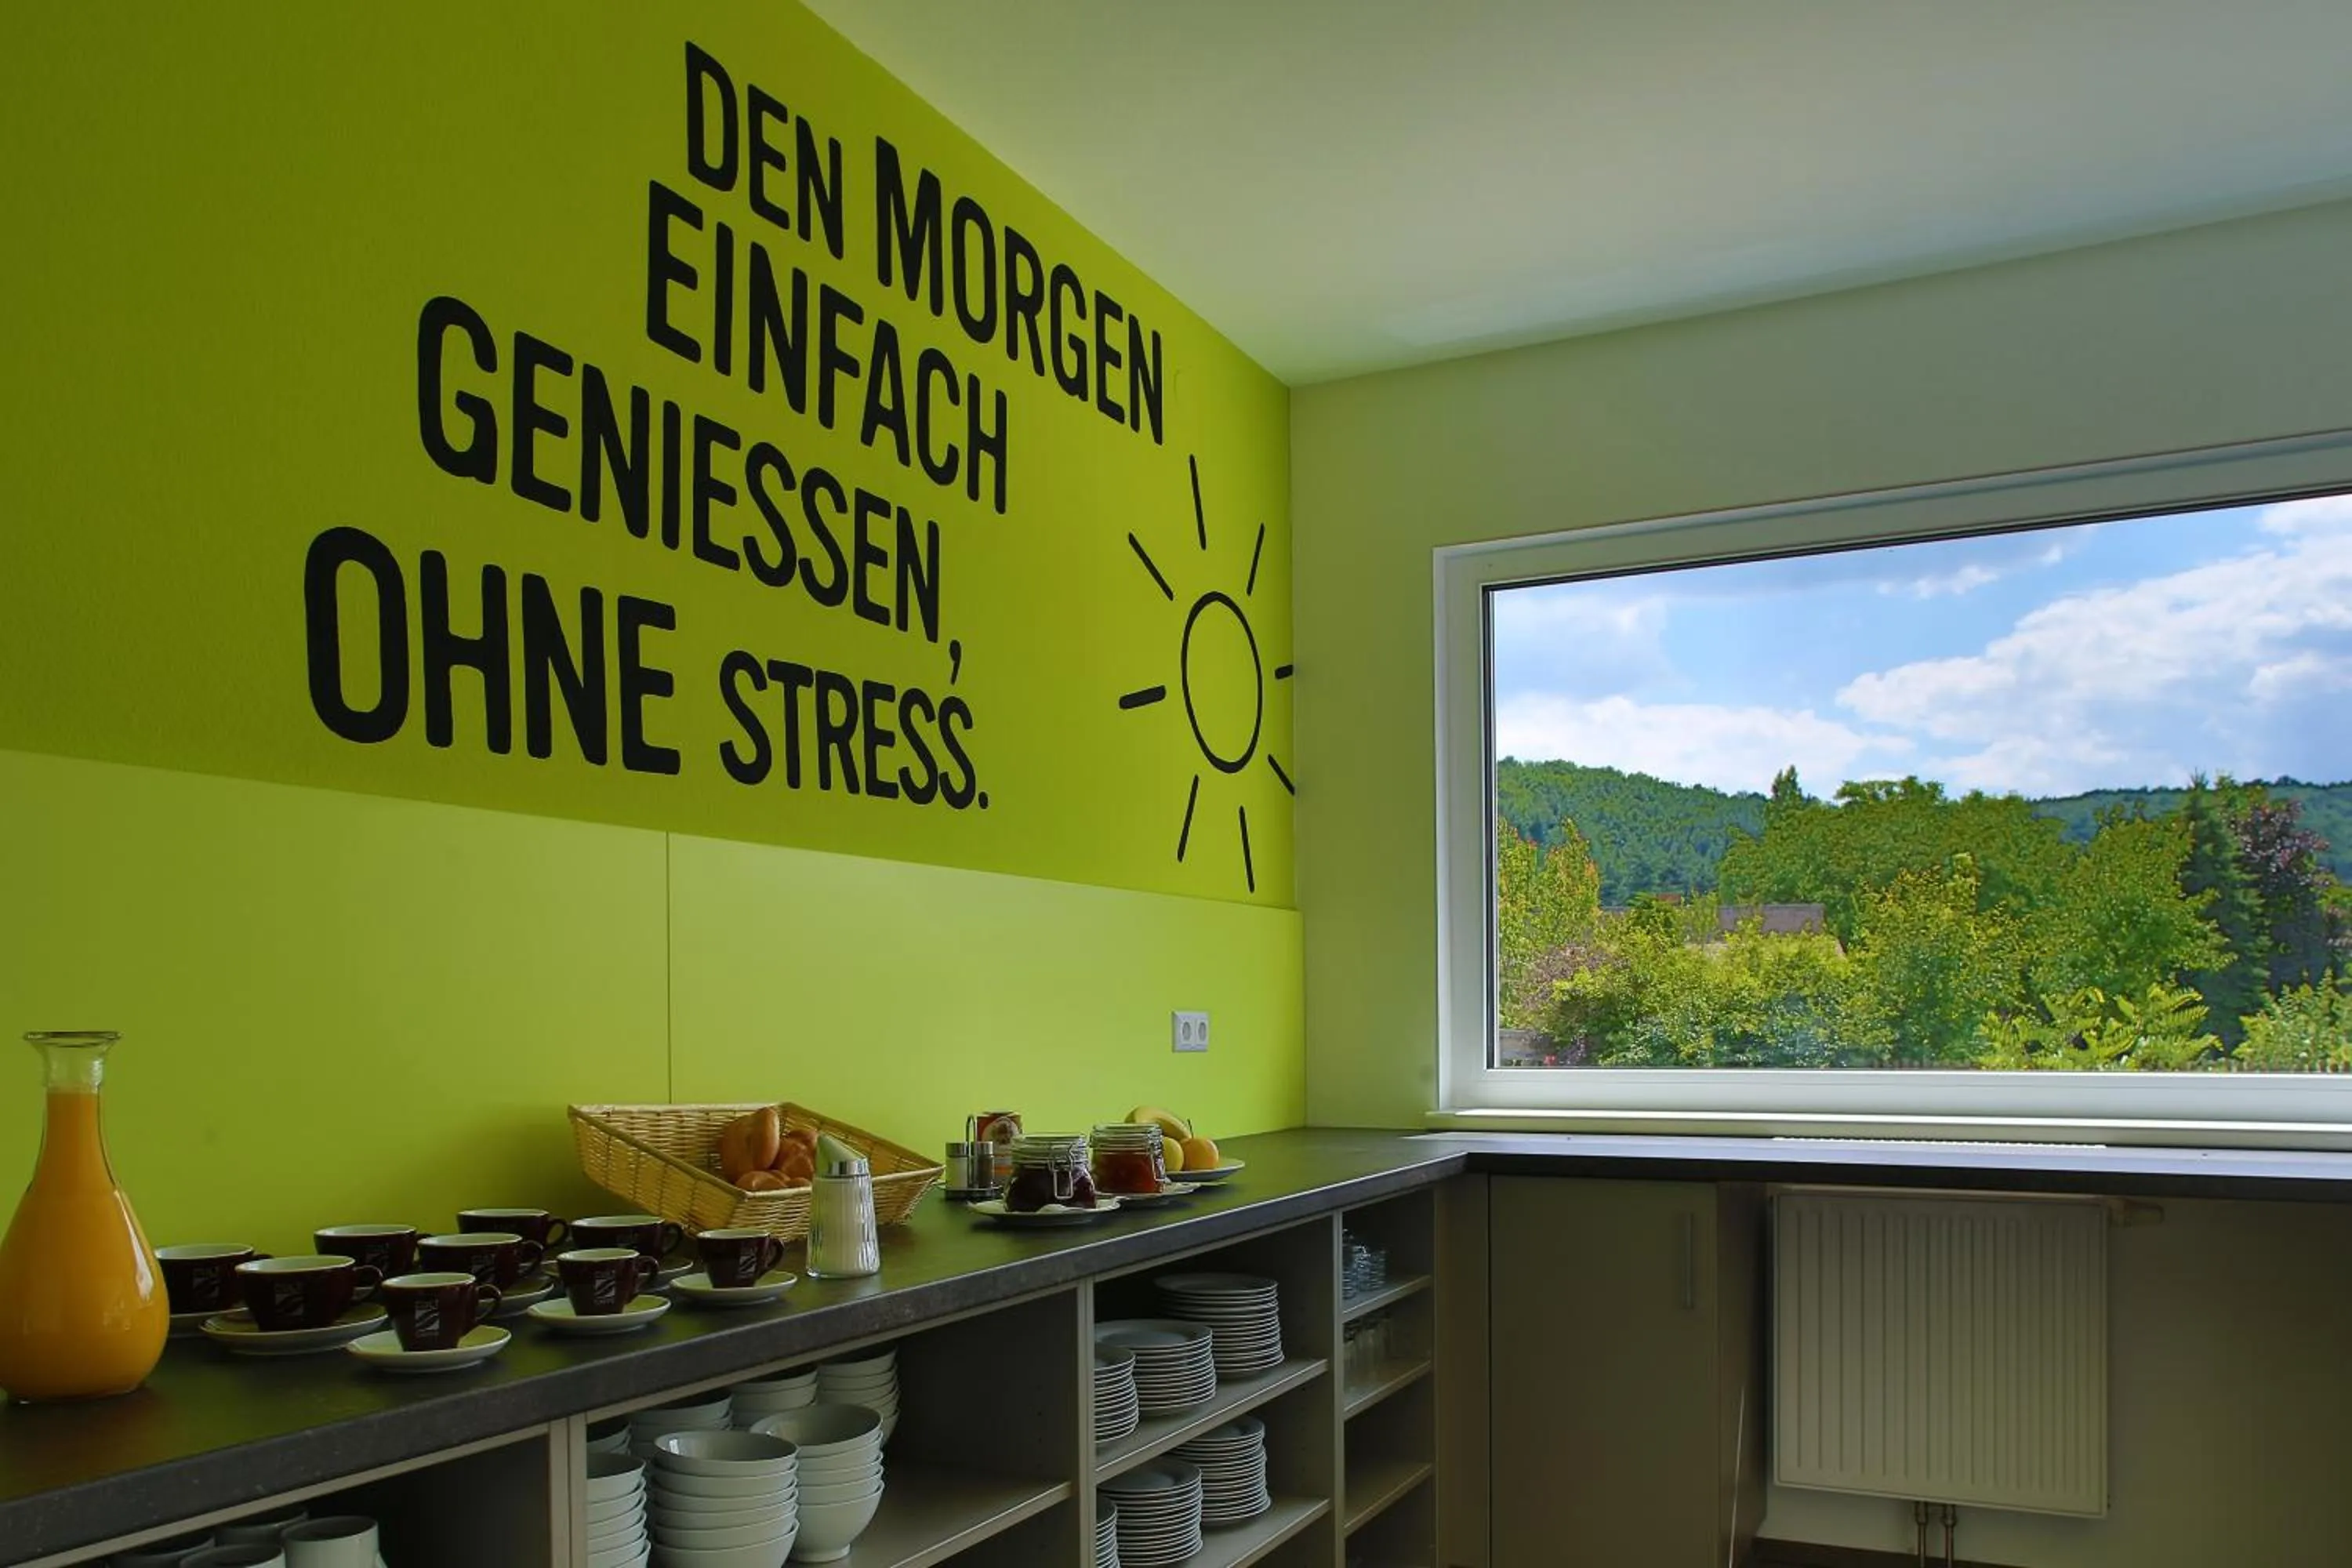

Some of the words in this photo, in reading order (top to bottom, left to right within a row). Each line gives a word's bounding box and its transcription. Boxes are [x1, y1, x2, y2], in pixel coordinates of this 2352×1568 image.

[647, 180, 1007, 514] EINFACH
[686, 41, 844, 260] DEN
[877, 136, 1163, 445] MORGEN
[304, 526, 681, 775] OHNE
[719, 650, 989, 815] STRESS.
[418, 296, 961, 684] GENIESSEN,
